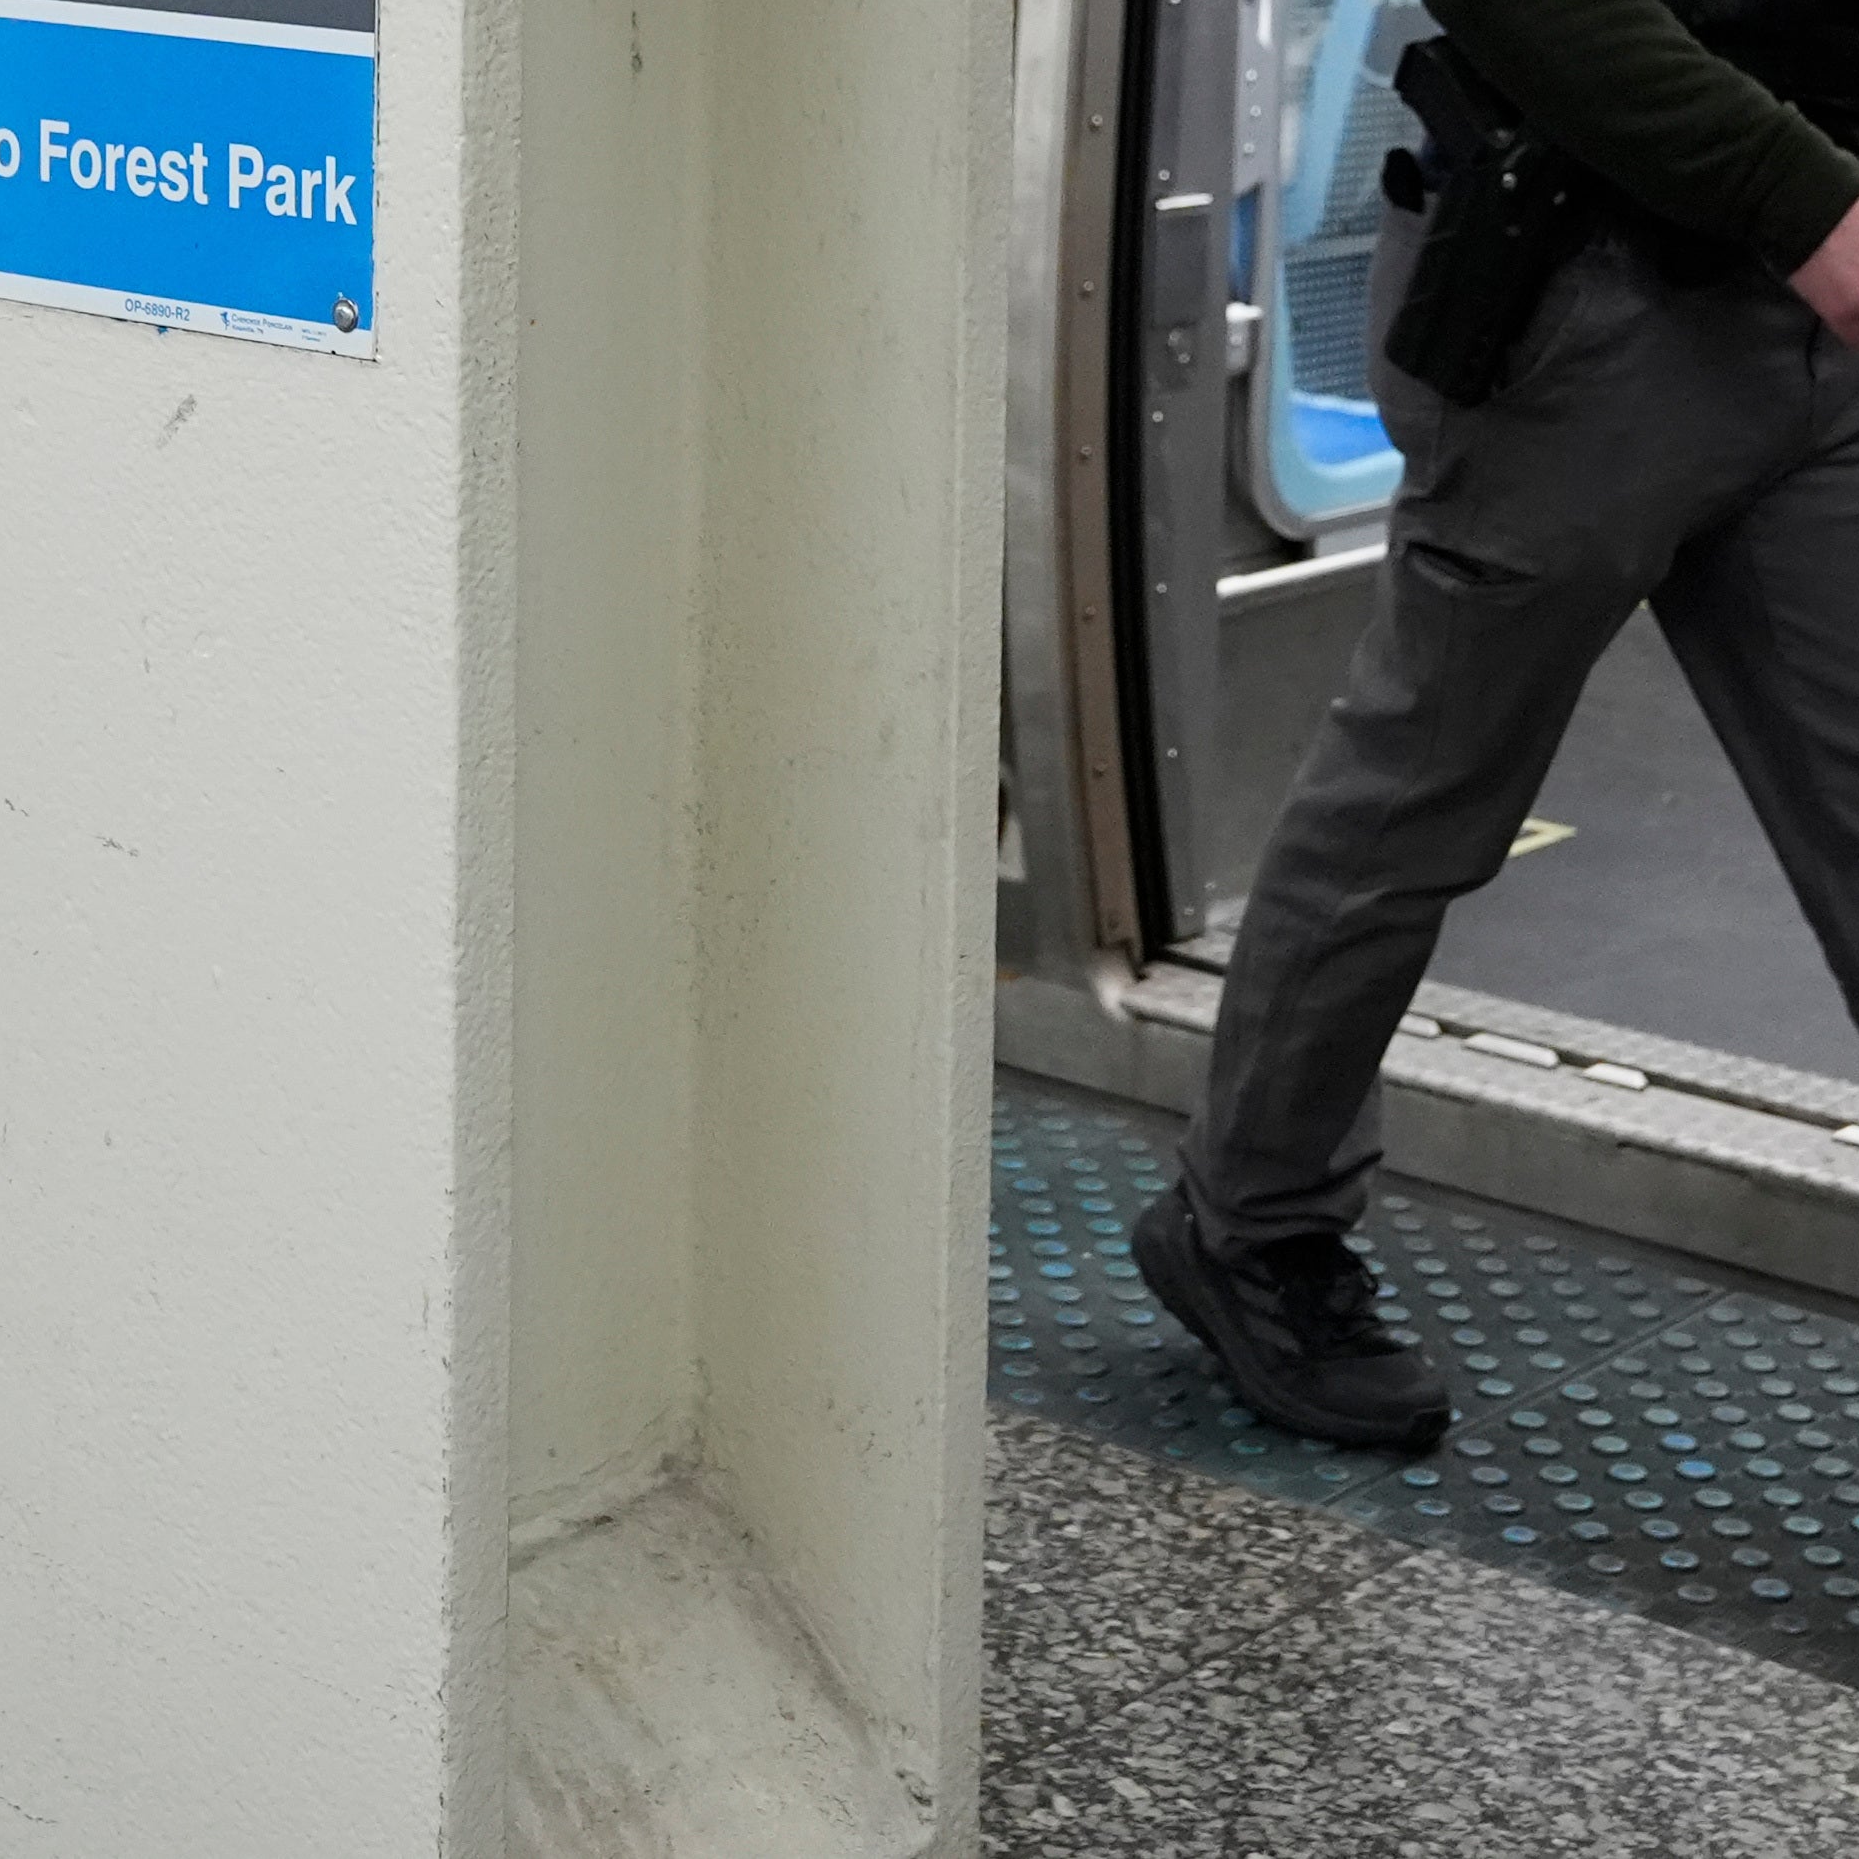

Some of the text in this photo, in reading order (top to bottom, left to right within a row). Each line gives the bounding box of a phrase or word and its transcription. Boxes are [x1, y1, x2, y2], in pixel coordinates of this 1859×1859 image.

[39, 118, 208, 205] Forest
[228, 142, 358, 226] Park
[124, 298, 190, 322] OP-6890-R2
